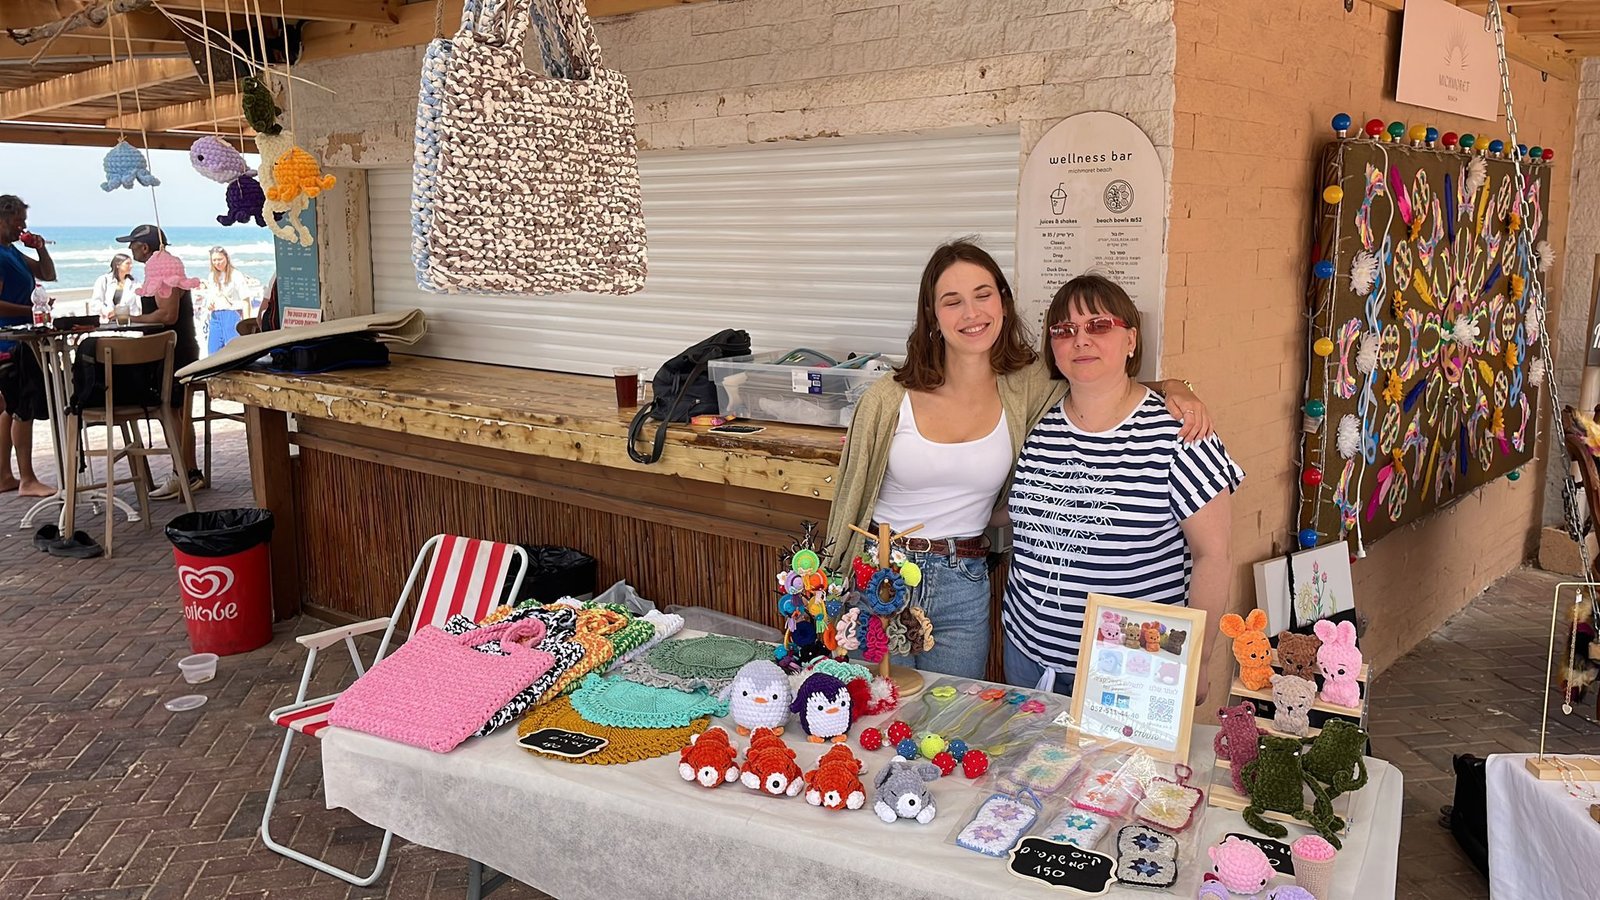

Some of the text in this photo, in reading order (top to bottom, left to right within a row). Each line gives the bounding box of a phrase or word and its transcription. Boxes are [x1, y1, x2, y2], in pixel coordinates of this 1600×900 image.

[1049, 151, 1133, 165] wellness bar
[1033, 865, 1065, 878] 150
